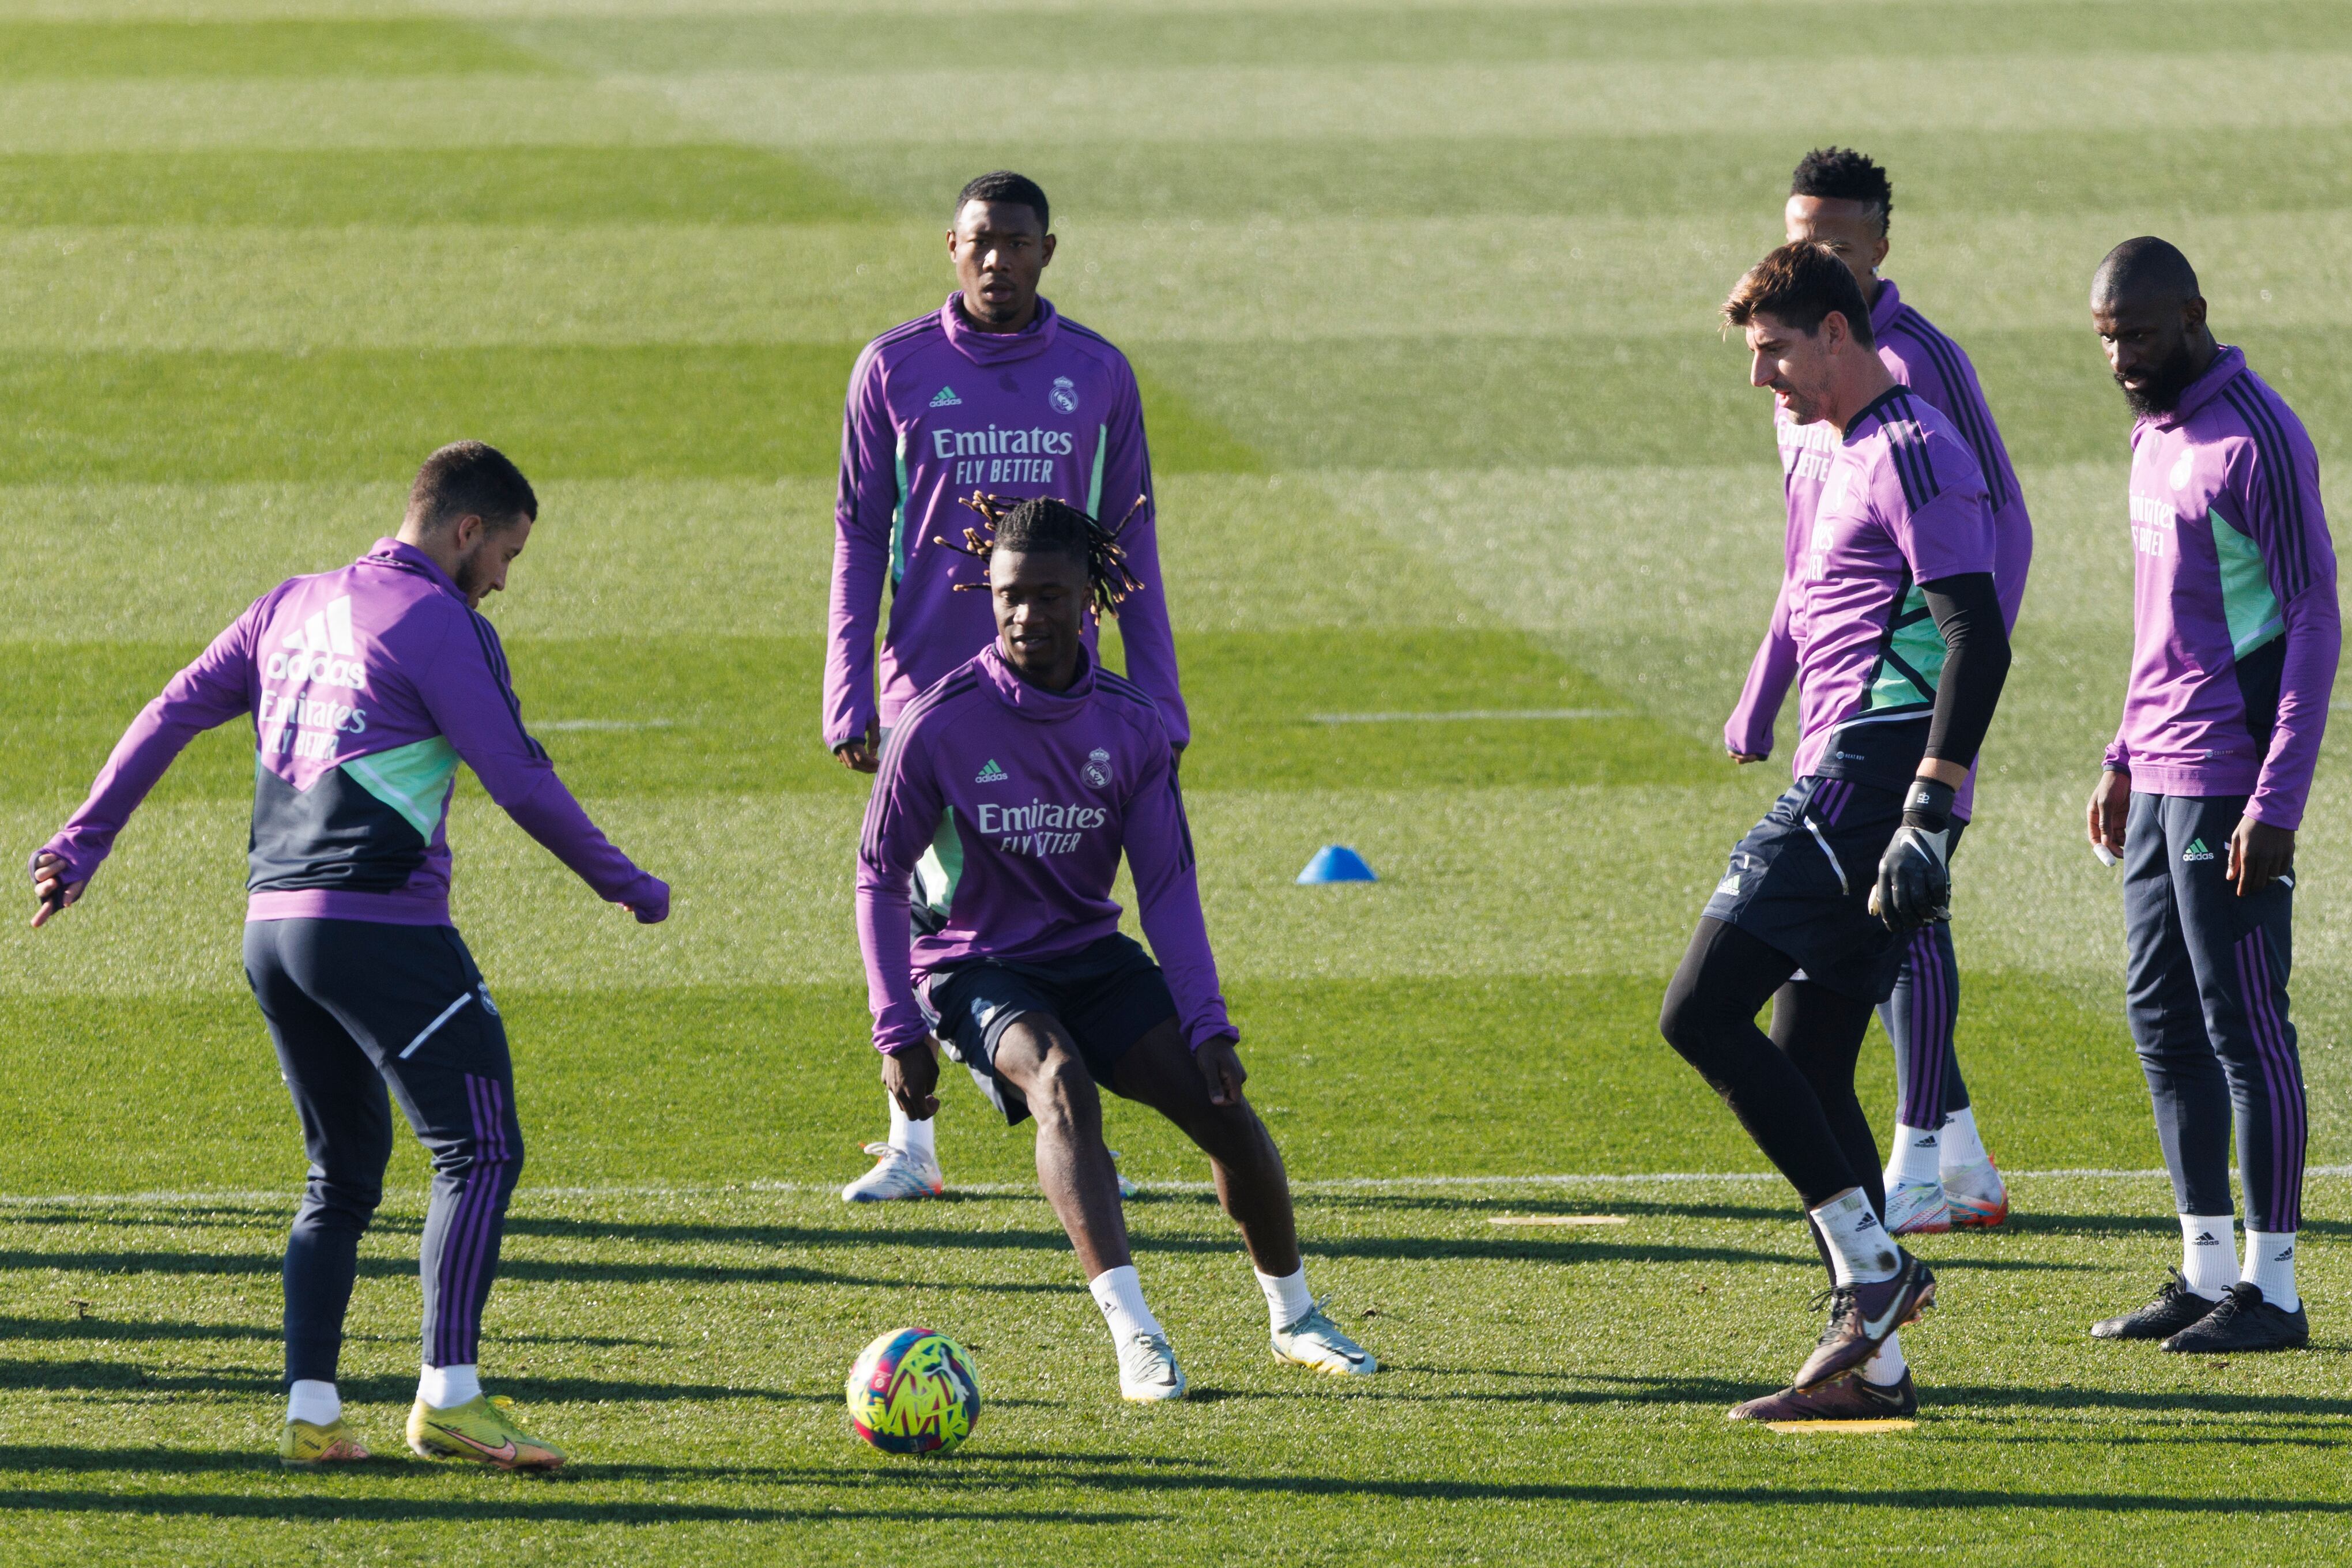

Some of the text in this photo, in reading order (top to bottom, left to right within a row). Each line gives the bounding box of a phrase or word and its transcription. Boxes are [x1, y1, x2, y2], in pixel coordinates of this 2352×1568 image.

[929, 397, 963, 408] adidas
[932, 423, 1073, 459] Emirates
[1777, 414, 1837, 453] Emirat
[955, 459, 1053, 485] FLY BETTER
[975, 771, 1008, 783] adidas
[977, 797, 1107, 834] Emirates
[1743, 854, 1750, 870] 1
[2183, 852, 2214, 862] adidas
